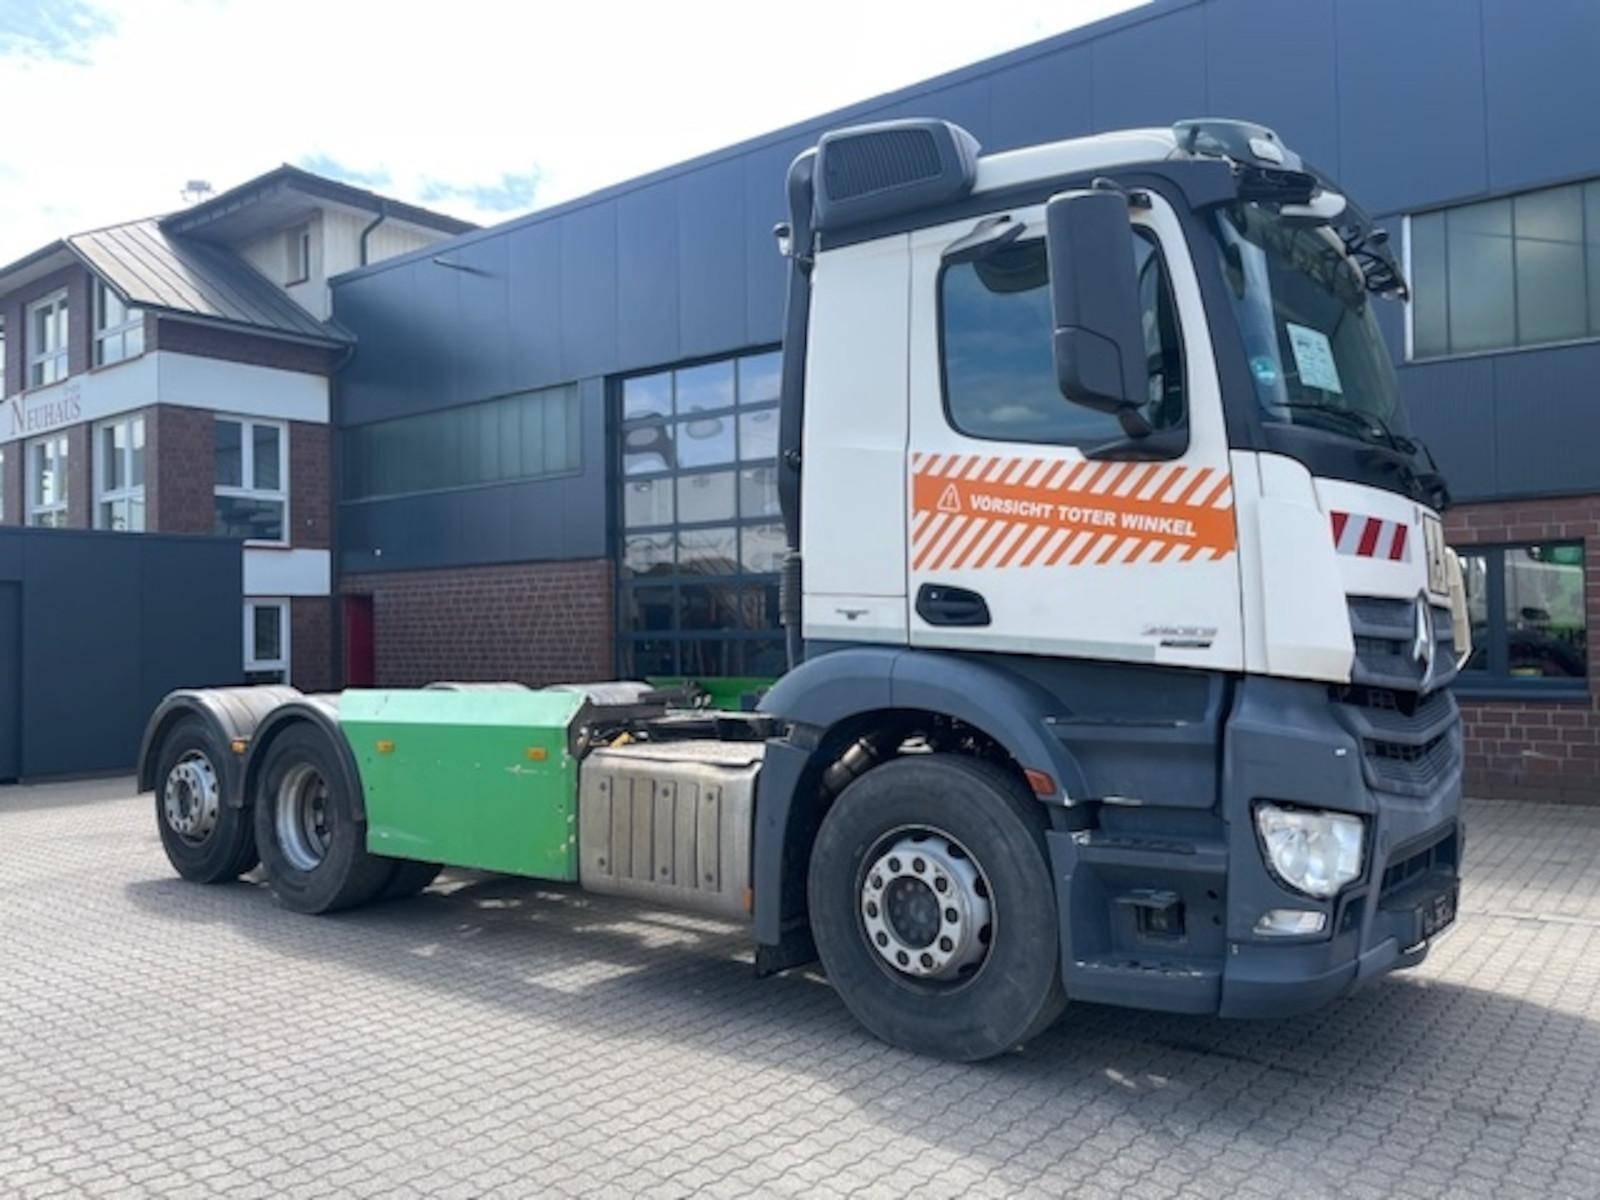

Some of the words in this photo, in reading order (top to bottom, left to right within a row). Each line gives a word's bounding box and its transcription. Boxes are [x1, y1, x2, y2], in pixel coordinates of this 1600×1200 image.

[11, 398, 81, 435] NEUHAUS
[970, 494, 1054, 519] VORSICHT
[1058, 505, 1117, 527] TOTER
[1121, 513, 1198, 537] WINKEL
